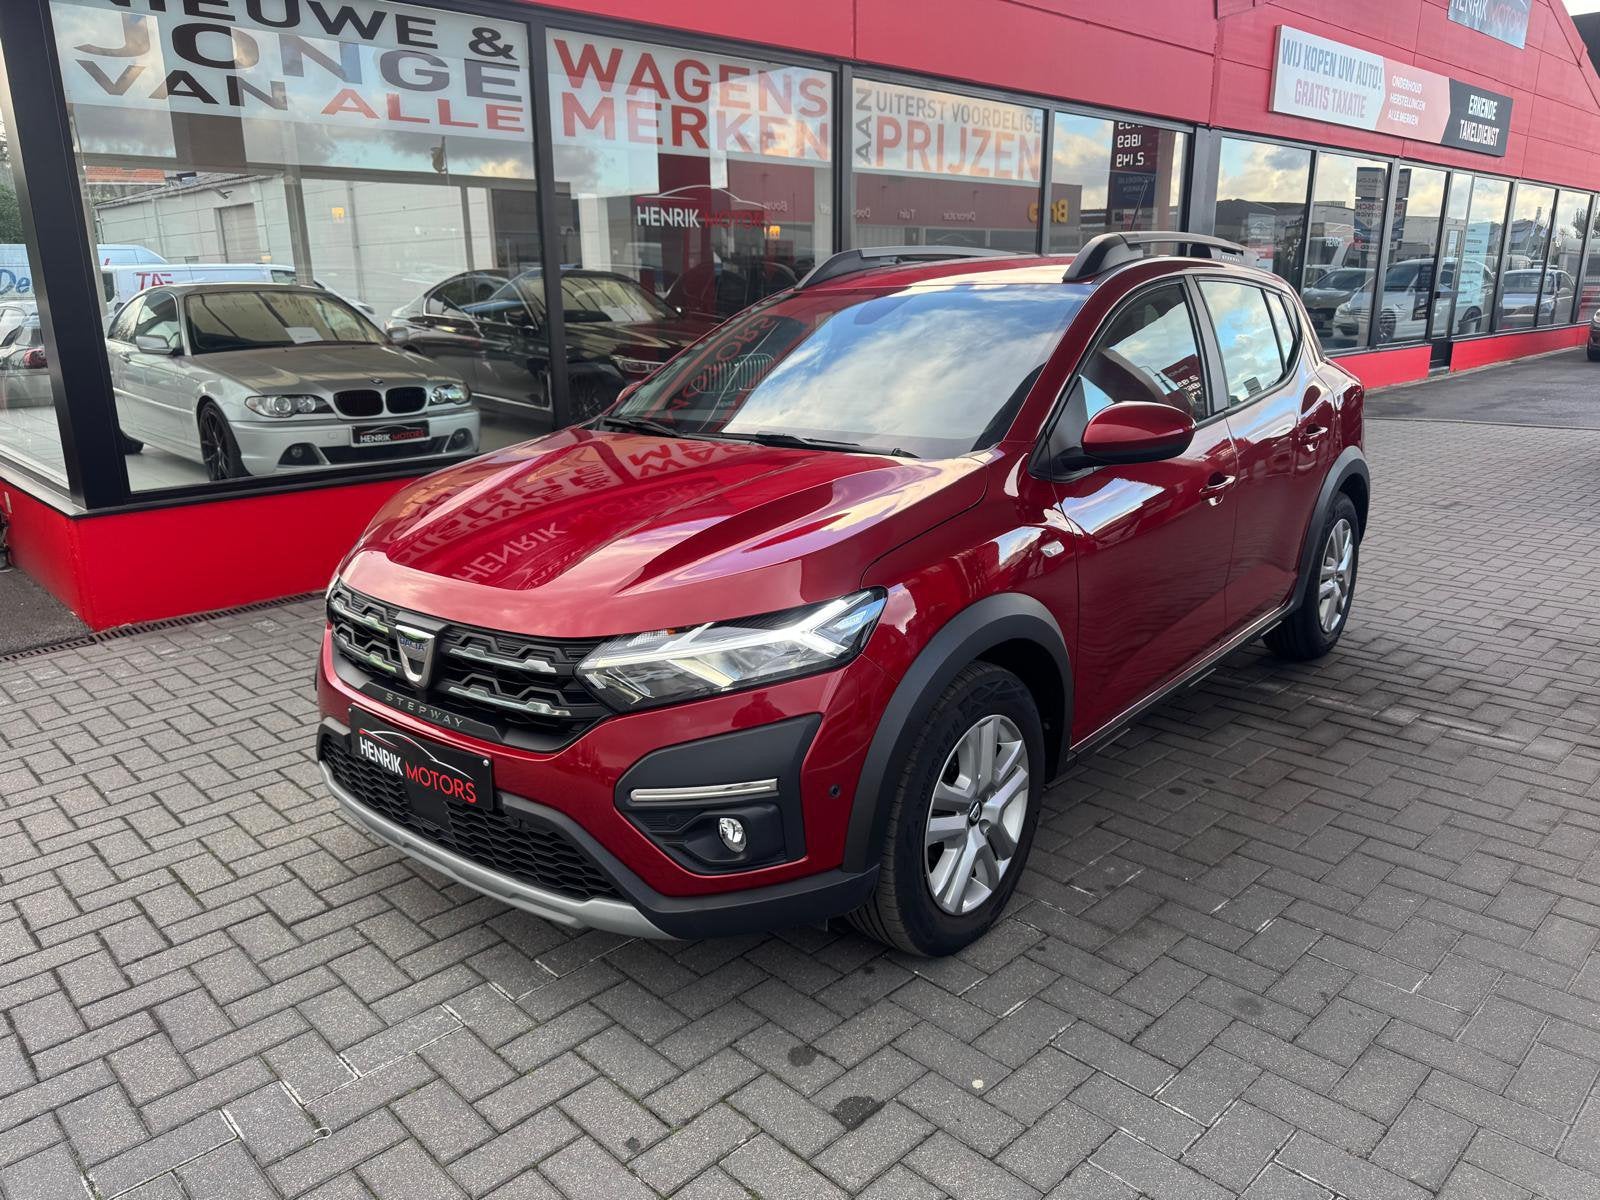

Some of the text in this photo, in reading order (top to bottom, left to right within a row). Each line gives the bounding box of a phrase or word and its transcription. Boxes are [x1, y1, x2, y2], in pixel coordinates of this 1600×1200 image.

[104, 0, 518, 60] EUWE &
[73, 12, 522, 102] JONGE
[553, 38, 828, 118] WAGENS
[1282, 38, 1383, 90] WIJ KOPEN UW AUTO!
[75, 59, 525, 132] VAN ALLE
[876, 90, 1041, 134] UITERST VOORDELIGE
[1295, 79, 1367, 118] GRATIS TAXATIE
[1468, 94, 1498, 120] ERKENDE
[562, 92, 828, 160] MERKEN
[856, 88, 872, 165] AAN
[876, 116, 1041, 181] PRIJZEN
[1460, 120, 1499, 147] TAKELDIENST
[637, 206, 700, 228] HENRIK
[360, 433, 391, 443] HENRIK
[400, 636, 426, 651] DAIA
[385, 693, 464, 728] STEPWAY
[359, 736, 477, 804] HENRIK MOTORS
